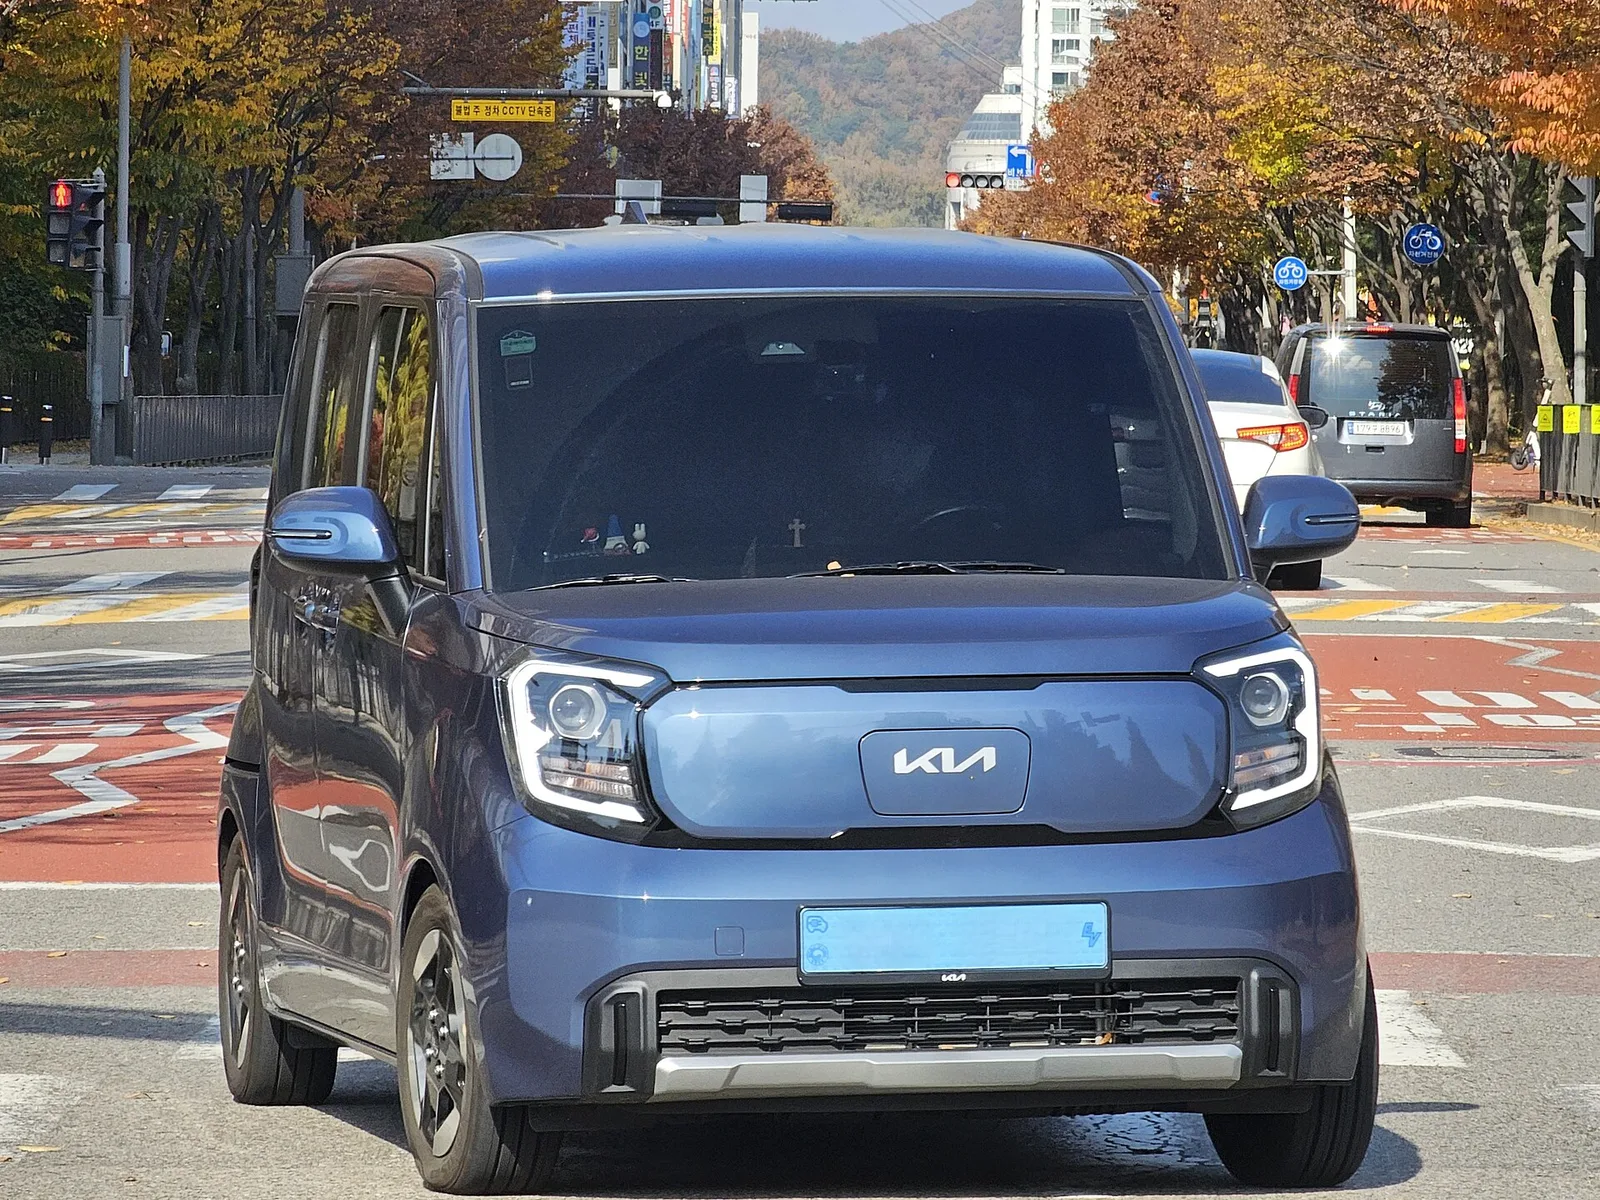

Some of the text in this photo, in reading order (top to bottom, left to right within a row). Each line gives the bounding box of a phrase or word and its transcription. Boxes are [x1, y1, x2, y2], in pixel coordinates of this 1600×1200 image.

[456, 105, 470, 116] 불법
[502, 106, 526, 115] CCTV
[528, 105, 552, 117] 단속중
[893, 746, 997, 774] KIA
[941, 973, 967, 982] KIA
